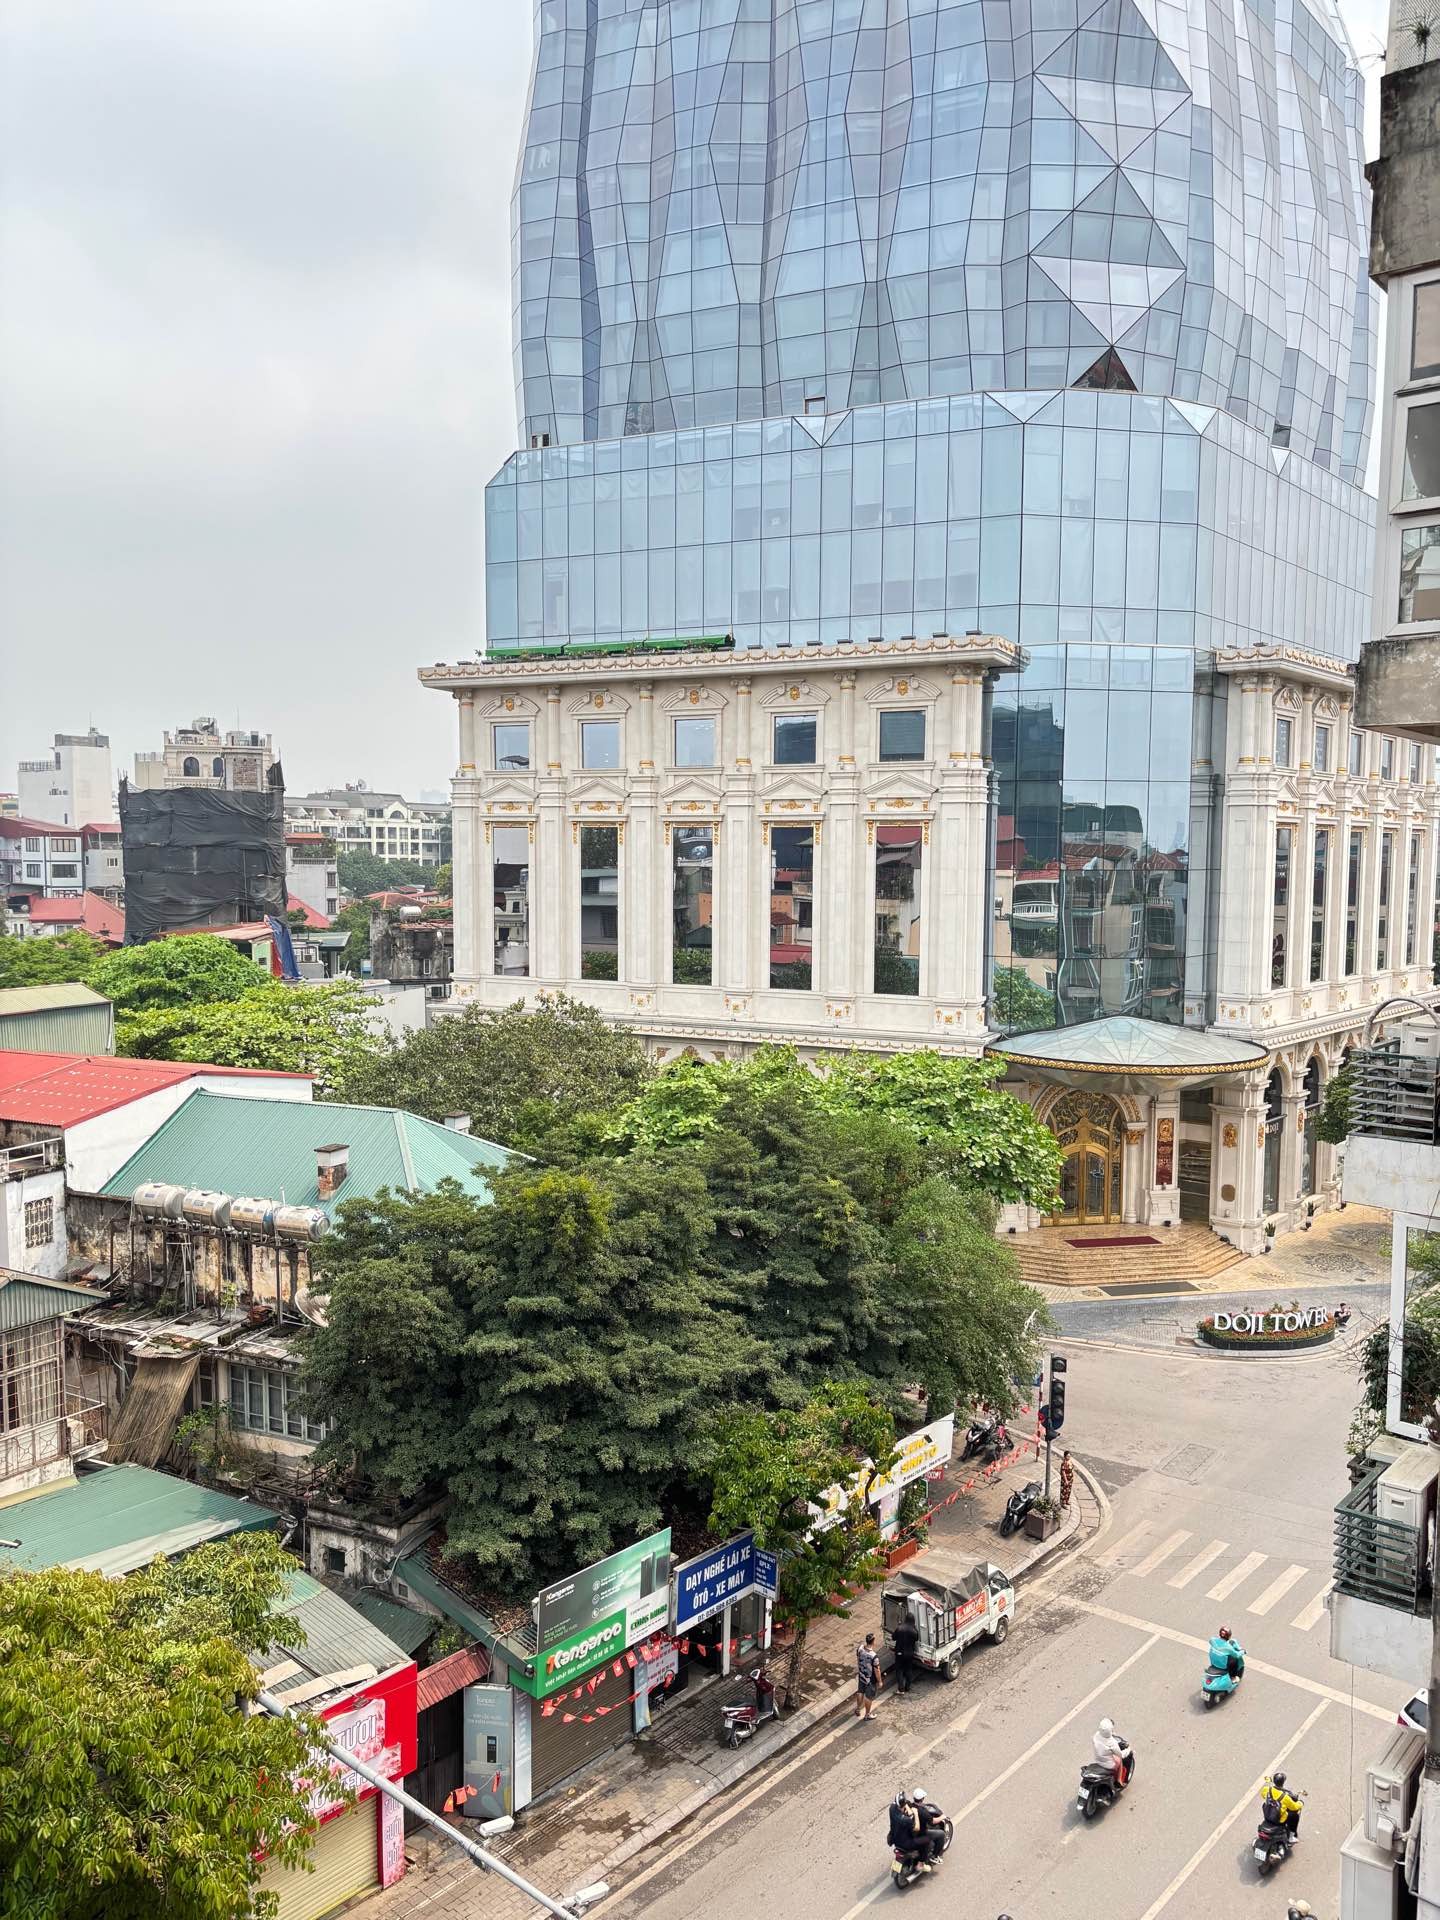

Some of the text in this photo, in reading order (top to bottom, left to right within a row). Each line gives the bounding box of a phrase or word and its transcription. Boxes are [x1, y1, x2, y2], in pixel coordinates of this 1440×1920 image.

[1213, 1307, 1329, 1335] DOJI TOWER
[686, 1570, 702, 1591] DẠY
[727, 1550, 739, 1570] LÁI
[741, 1545, 750, 1562] XE
[692, 1587, 709, 1610] ÔTÔ
[716, 1580, 726, 1598] XE
[728, 1570, 745, 1591] MÁY
[546, 1622, 622, 1675] Kangaroo
